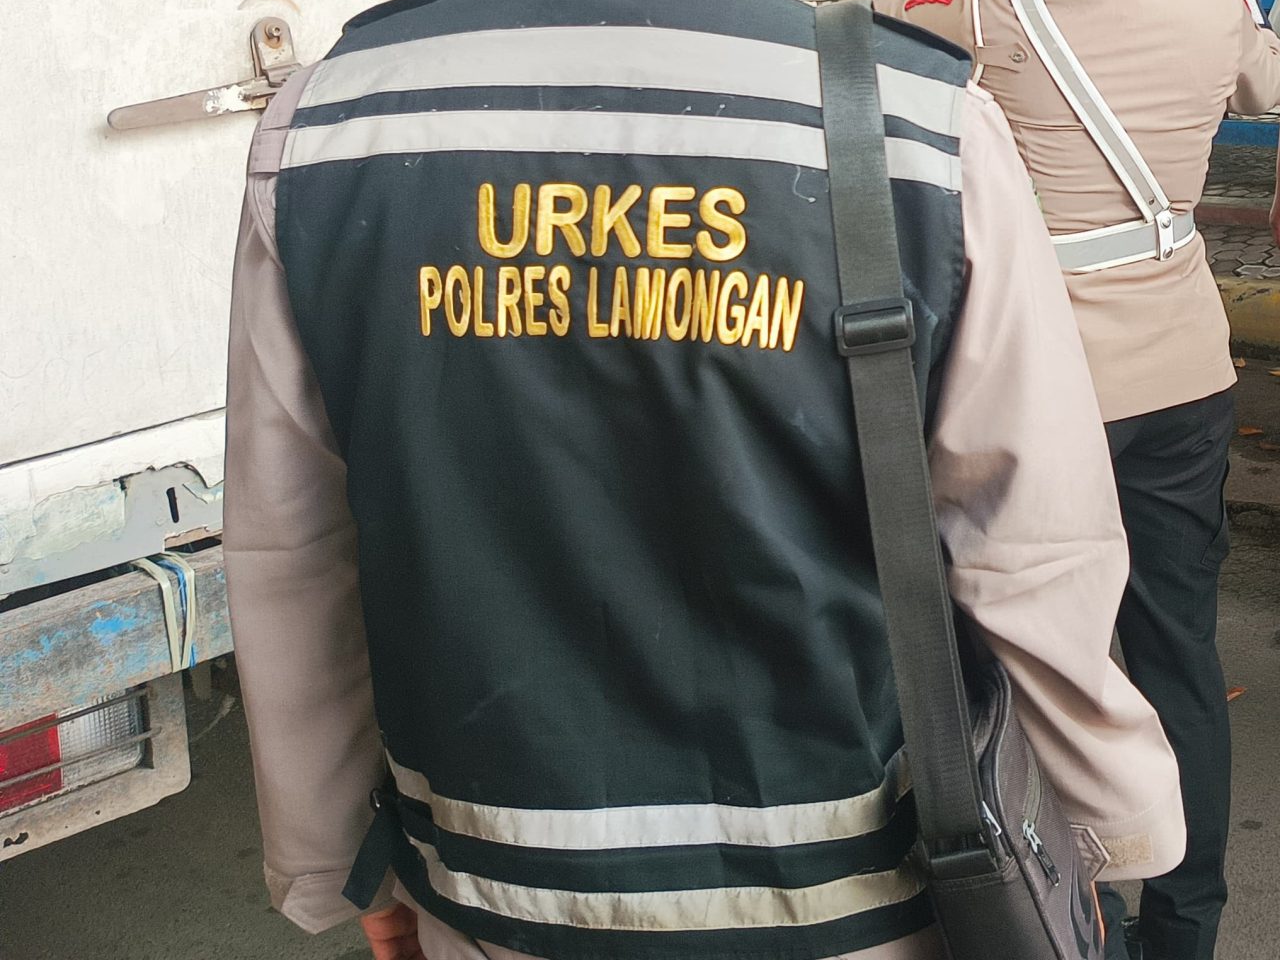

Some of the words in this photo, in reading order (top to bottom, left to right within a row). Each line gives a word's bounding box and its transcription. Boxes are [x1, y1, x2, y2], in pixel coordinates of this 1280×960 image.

[477, 181, 748, 263] URKES
[419, 265, 572, 338] POLRES
[587, 266, 805, 352] LAMONGAN
